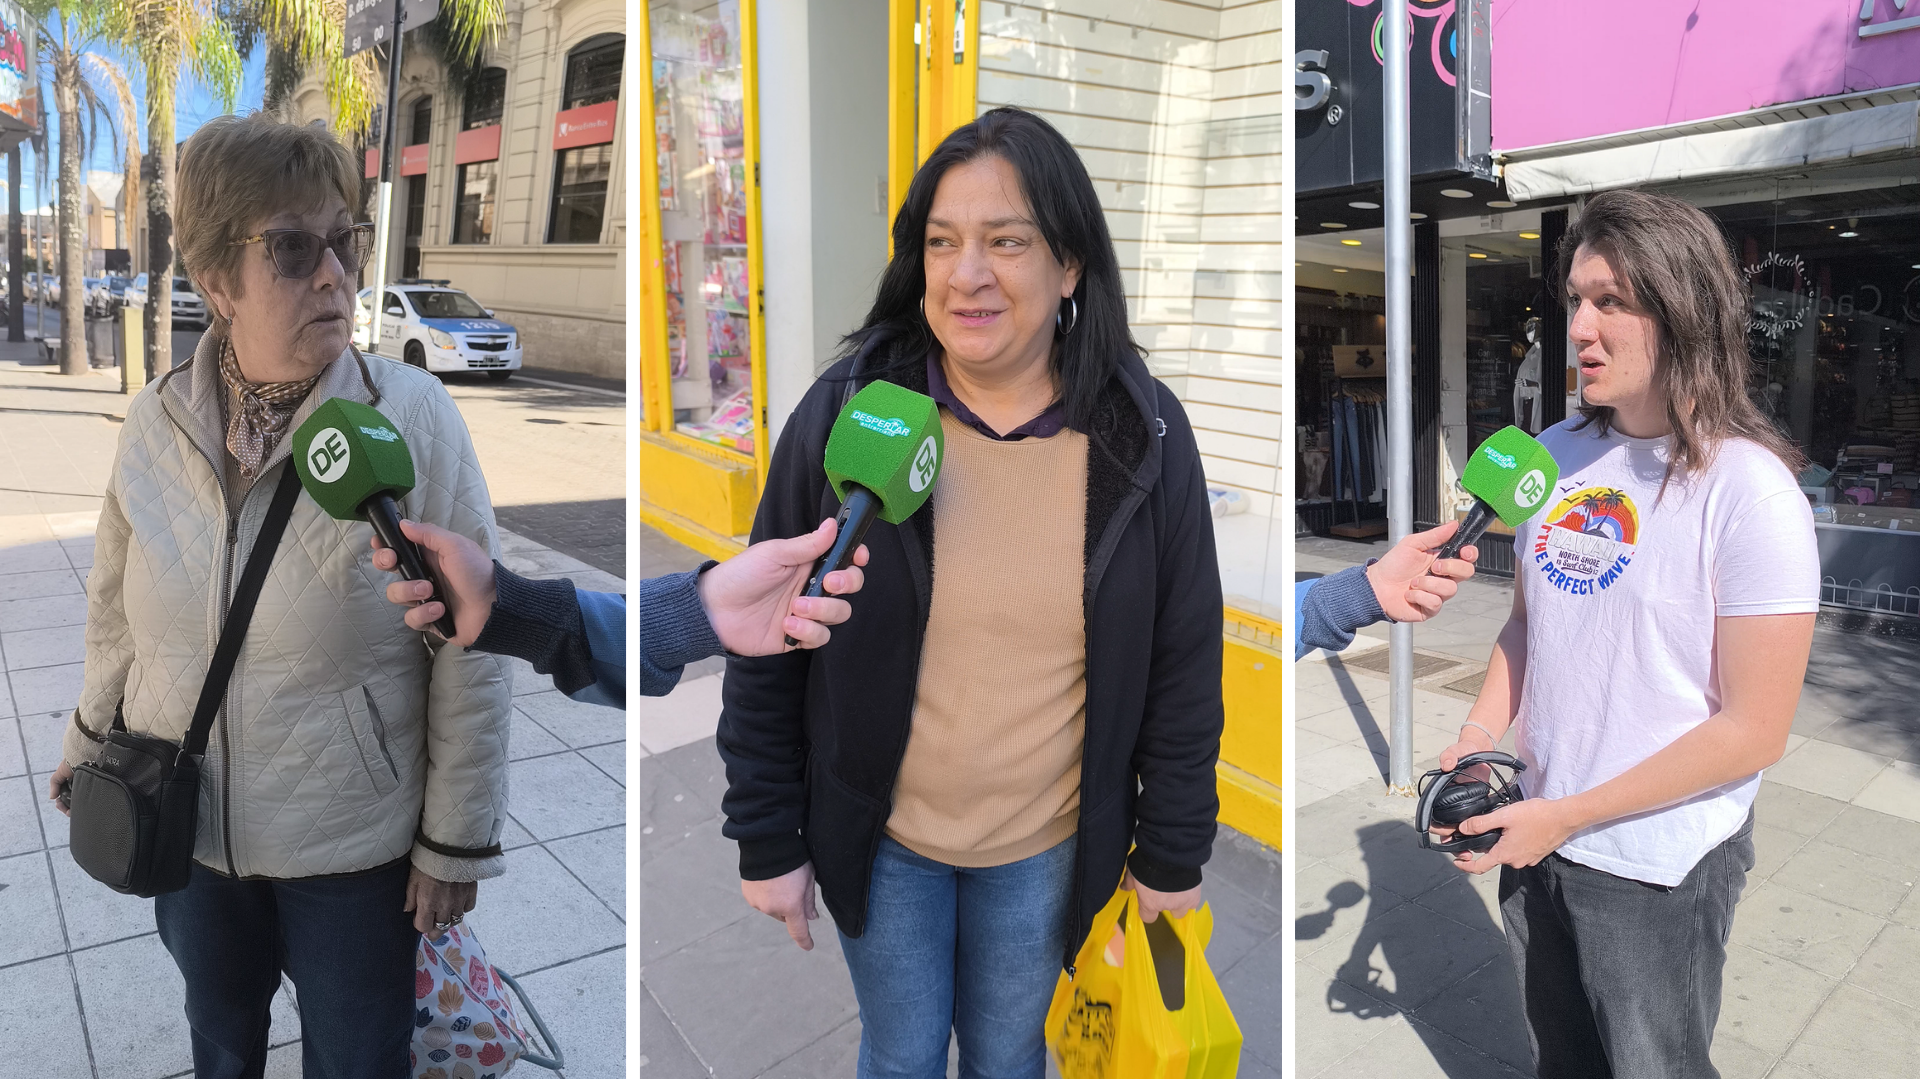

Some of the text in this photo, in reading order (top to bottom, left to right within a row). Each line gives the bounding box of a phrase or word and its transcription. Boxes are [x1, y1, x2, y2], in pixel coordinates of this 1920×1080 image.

[311, 432, 347, 477] DE
[916, 442, 935, 486] DE
[1519, 474, 1543, 505] DE
[1548, 528, 1620, 563] HAWAII
[1558, 550, 1600, 568] NORTH SHORE
[1541, 561, 1594, 596] PERFECT
[1597, 553, 1631, 590] WAVE
